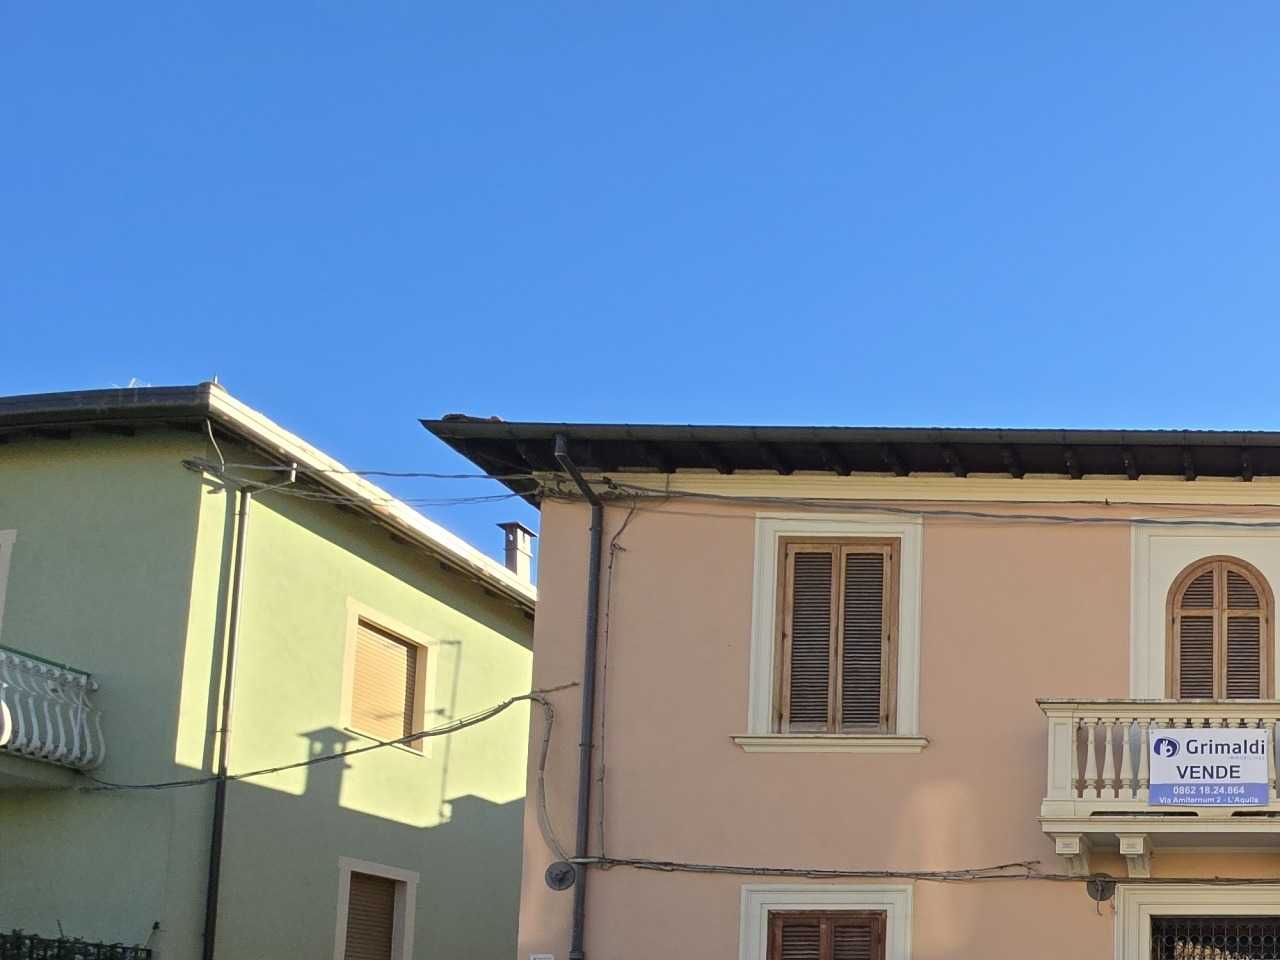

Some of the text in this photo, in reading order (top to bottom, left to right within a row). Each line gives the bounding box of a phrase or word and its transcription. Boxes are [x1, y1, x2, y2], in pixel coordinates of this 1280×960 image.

[1186, 739, 1265, 755] Grimaldi
[1176, 765, 1241, 779] VENDE
[1173, 786, 1245, 795] 0862 18.24.864
